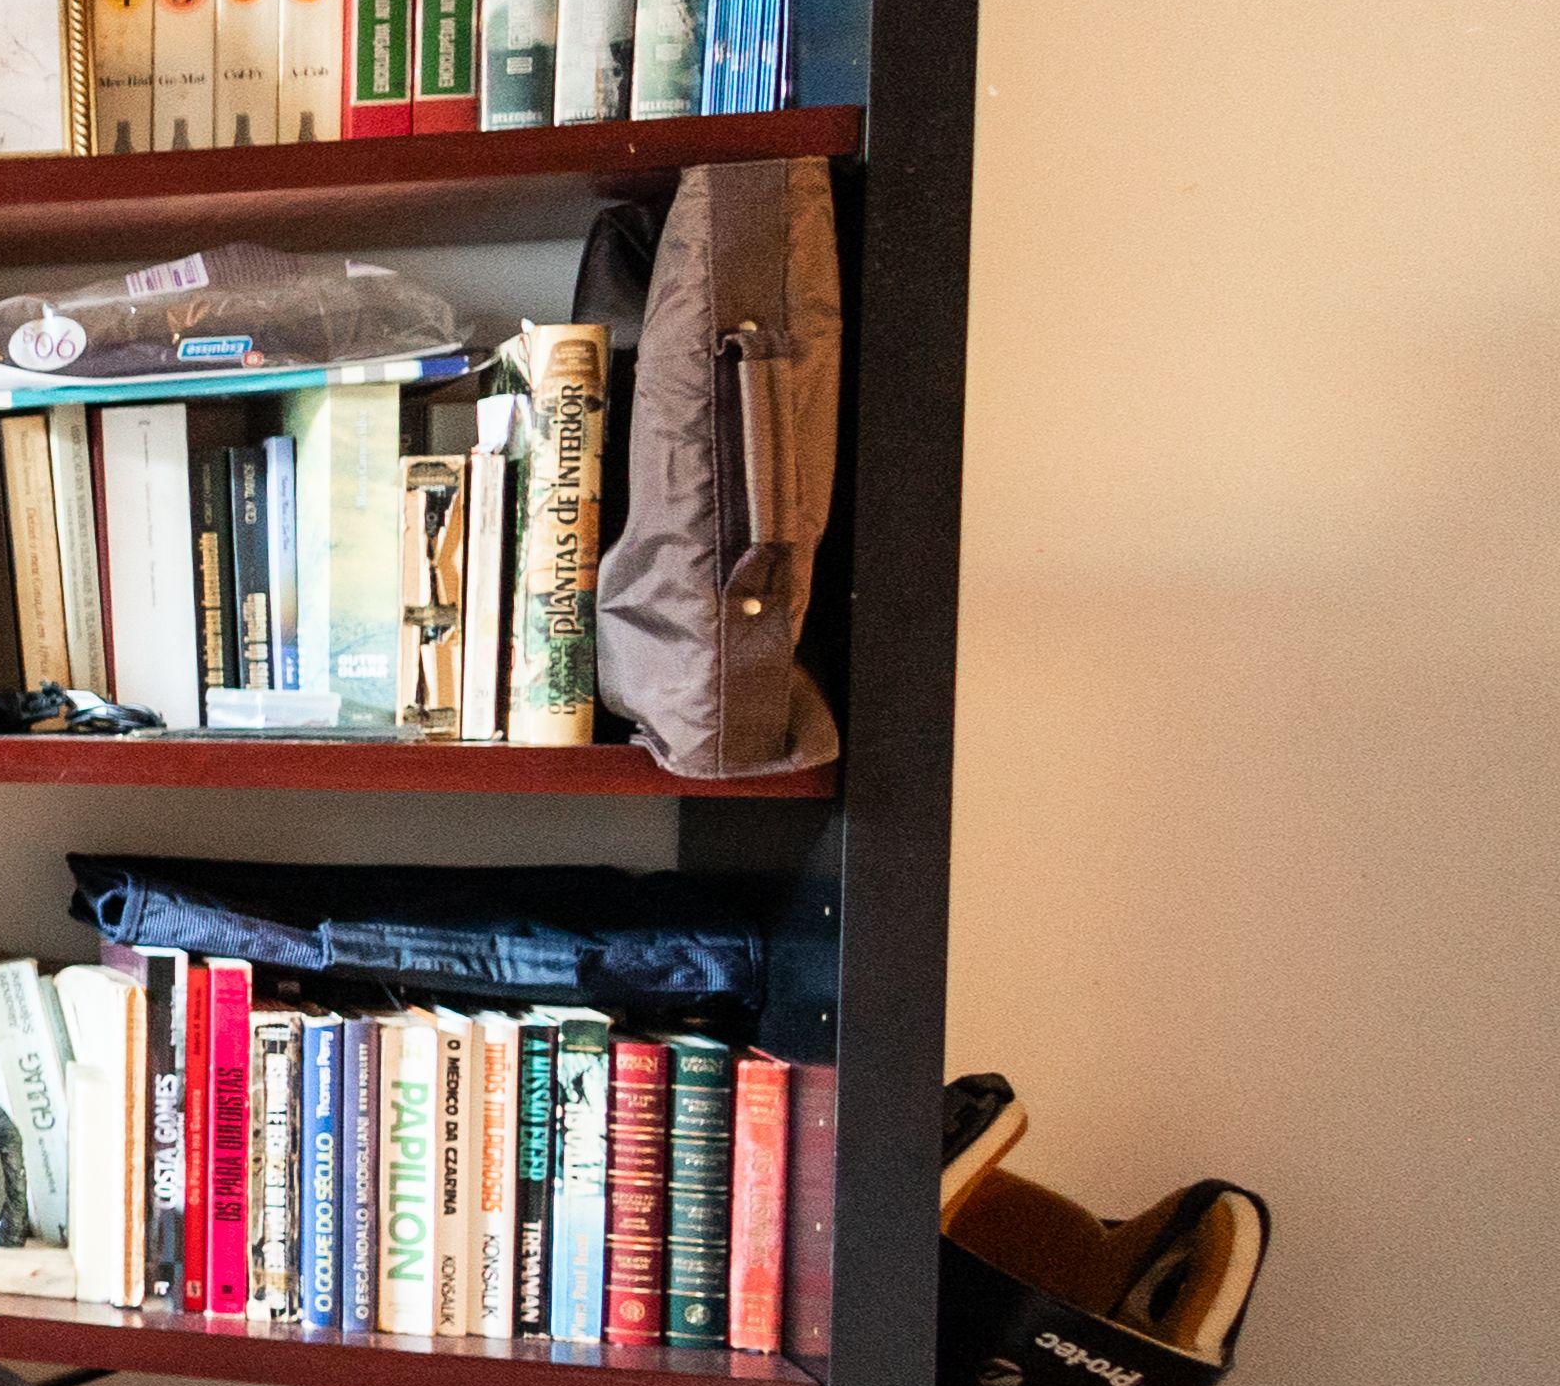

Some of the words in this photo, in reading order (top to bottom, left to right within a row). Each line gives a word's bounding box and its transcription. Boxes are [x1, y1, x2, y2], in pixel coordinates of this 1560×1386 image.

[317, 1030, 333, 1065] Perry
[447, 1039, 461, 1050] O
[18, 1051, 55, 1131] GULAG
[154, 1073, 178, 1143] GOMES
[316, 1068, 331, 1119] Thomas
[445, 1057, 461, 1116] MÉDICO
[356, 1116, 369, 1204] MODIGLIANI
[445, 1121, 458, 1142] DA
[154, 1148, 178, 1209] COSTA
[313, 1133, 333, 1200] SÉCULO
[387, 1080, 429, 1281] PAPILLON
[444, 1147, 458, 1216] CZARINA
[215, 1201, 243, 1222] OS
[316, 1202, 332, 1232] DO
[316, 1235, 333, 1292] GOLPE
[352, 1208, 370, 1304] ESCÂNDALO
[481, 1234, 501, 1321] KONSALIK
[521, 1220, 543, 1323] TREVANIAN
[317, 1294, 333, 1312] O
[356, 1304, 369, 1319] O
[441, 1255, 456, 1328] KONSALIK
